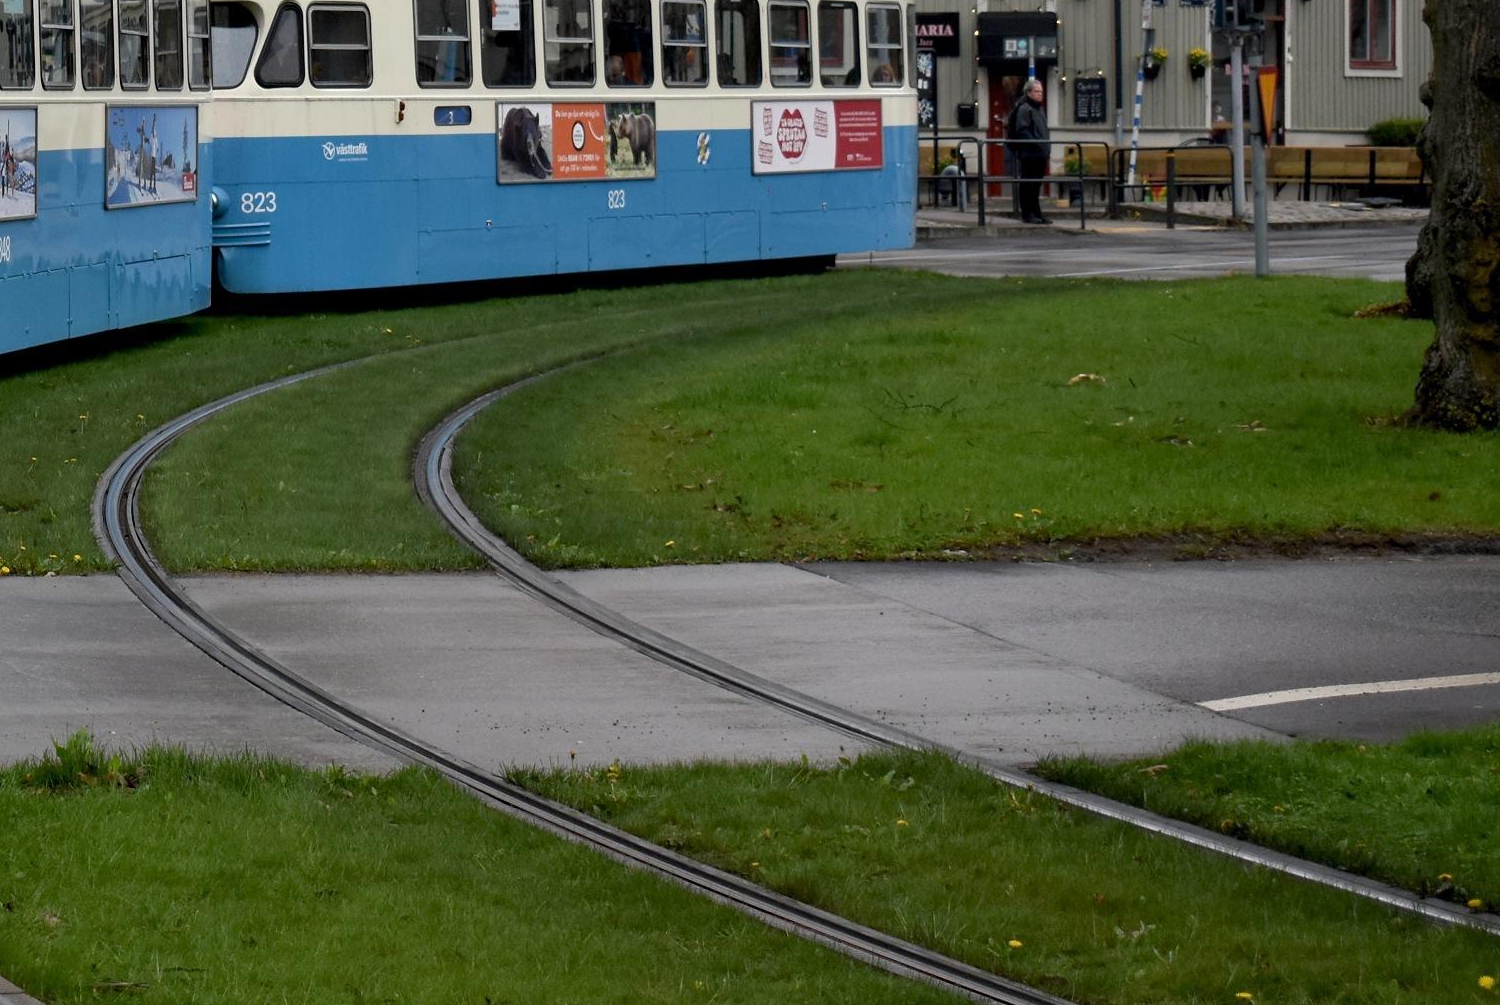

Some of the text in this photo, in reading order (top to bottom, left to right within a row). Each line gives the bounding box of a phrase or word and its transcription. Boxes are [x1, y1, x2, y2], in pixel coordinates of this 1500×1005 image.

[336, 143, 368, 155] västtrafik
[241, 192, 277, 213] 823
[608, 189, 625, 209] 823
